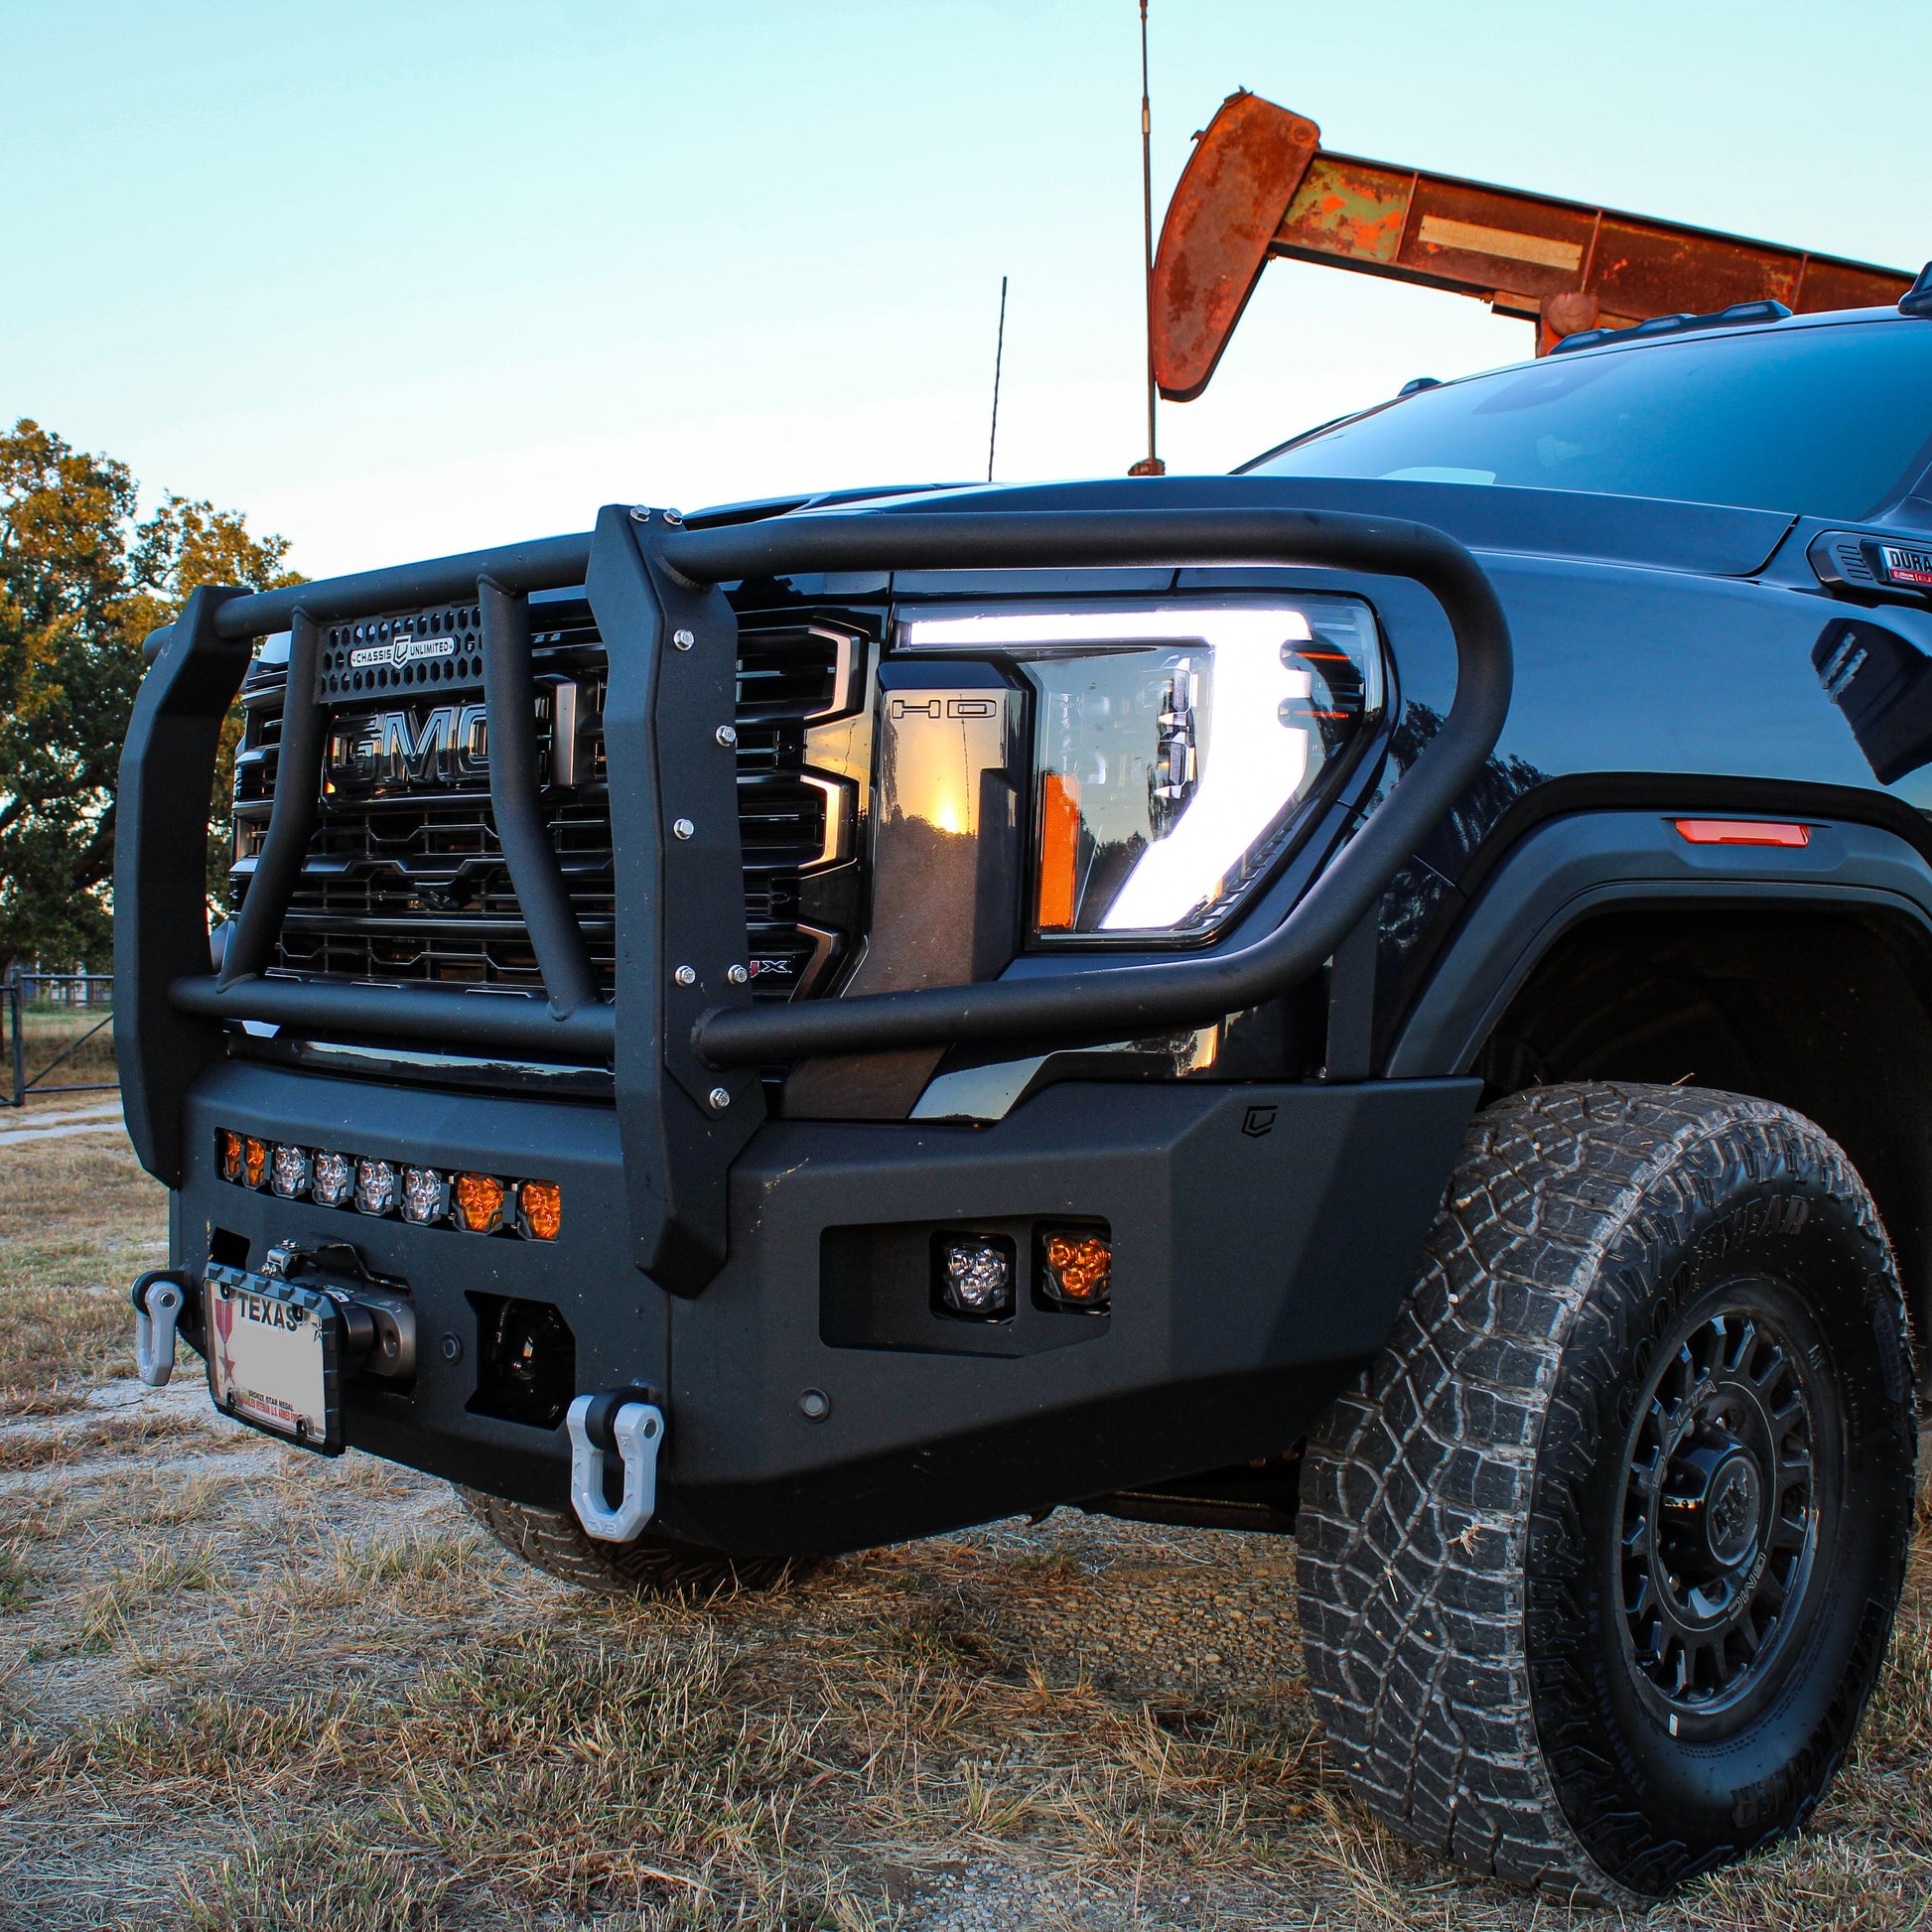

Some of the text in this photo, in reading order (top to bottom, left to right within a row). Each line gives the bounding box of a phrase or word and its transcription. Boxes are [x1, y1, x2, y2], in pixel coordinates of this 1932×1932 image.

[1890, 550, 1932, 572] DURA
[356, 641, 448, 663] CHASSIS UNLIMITED
[892, 699, 997, 719] HD
[240, 1293, 298, 1331] TEXAS
[1727, 1551, 1767, 1621] GMC
